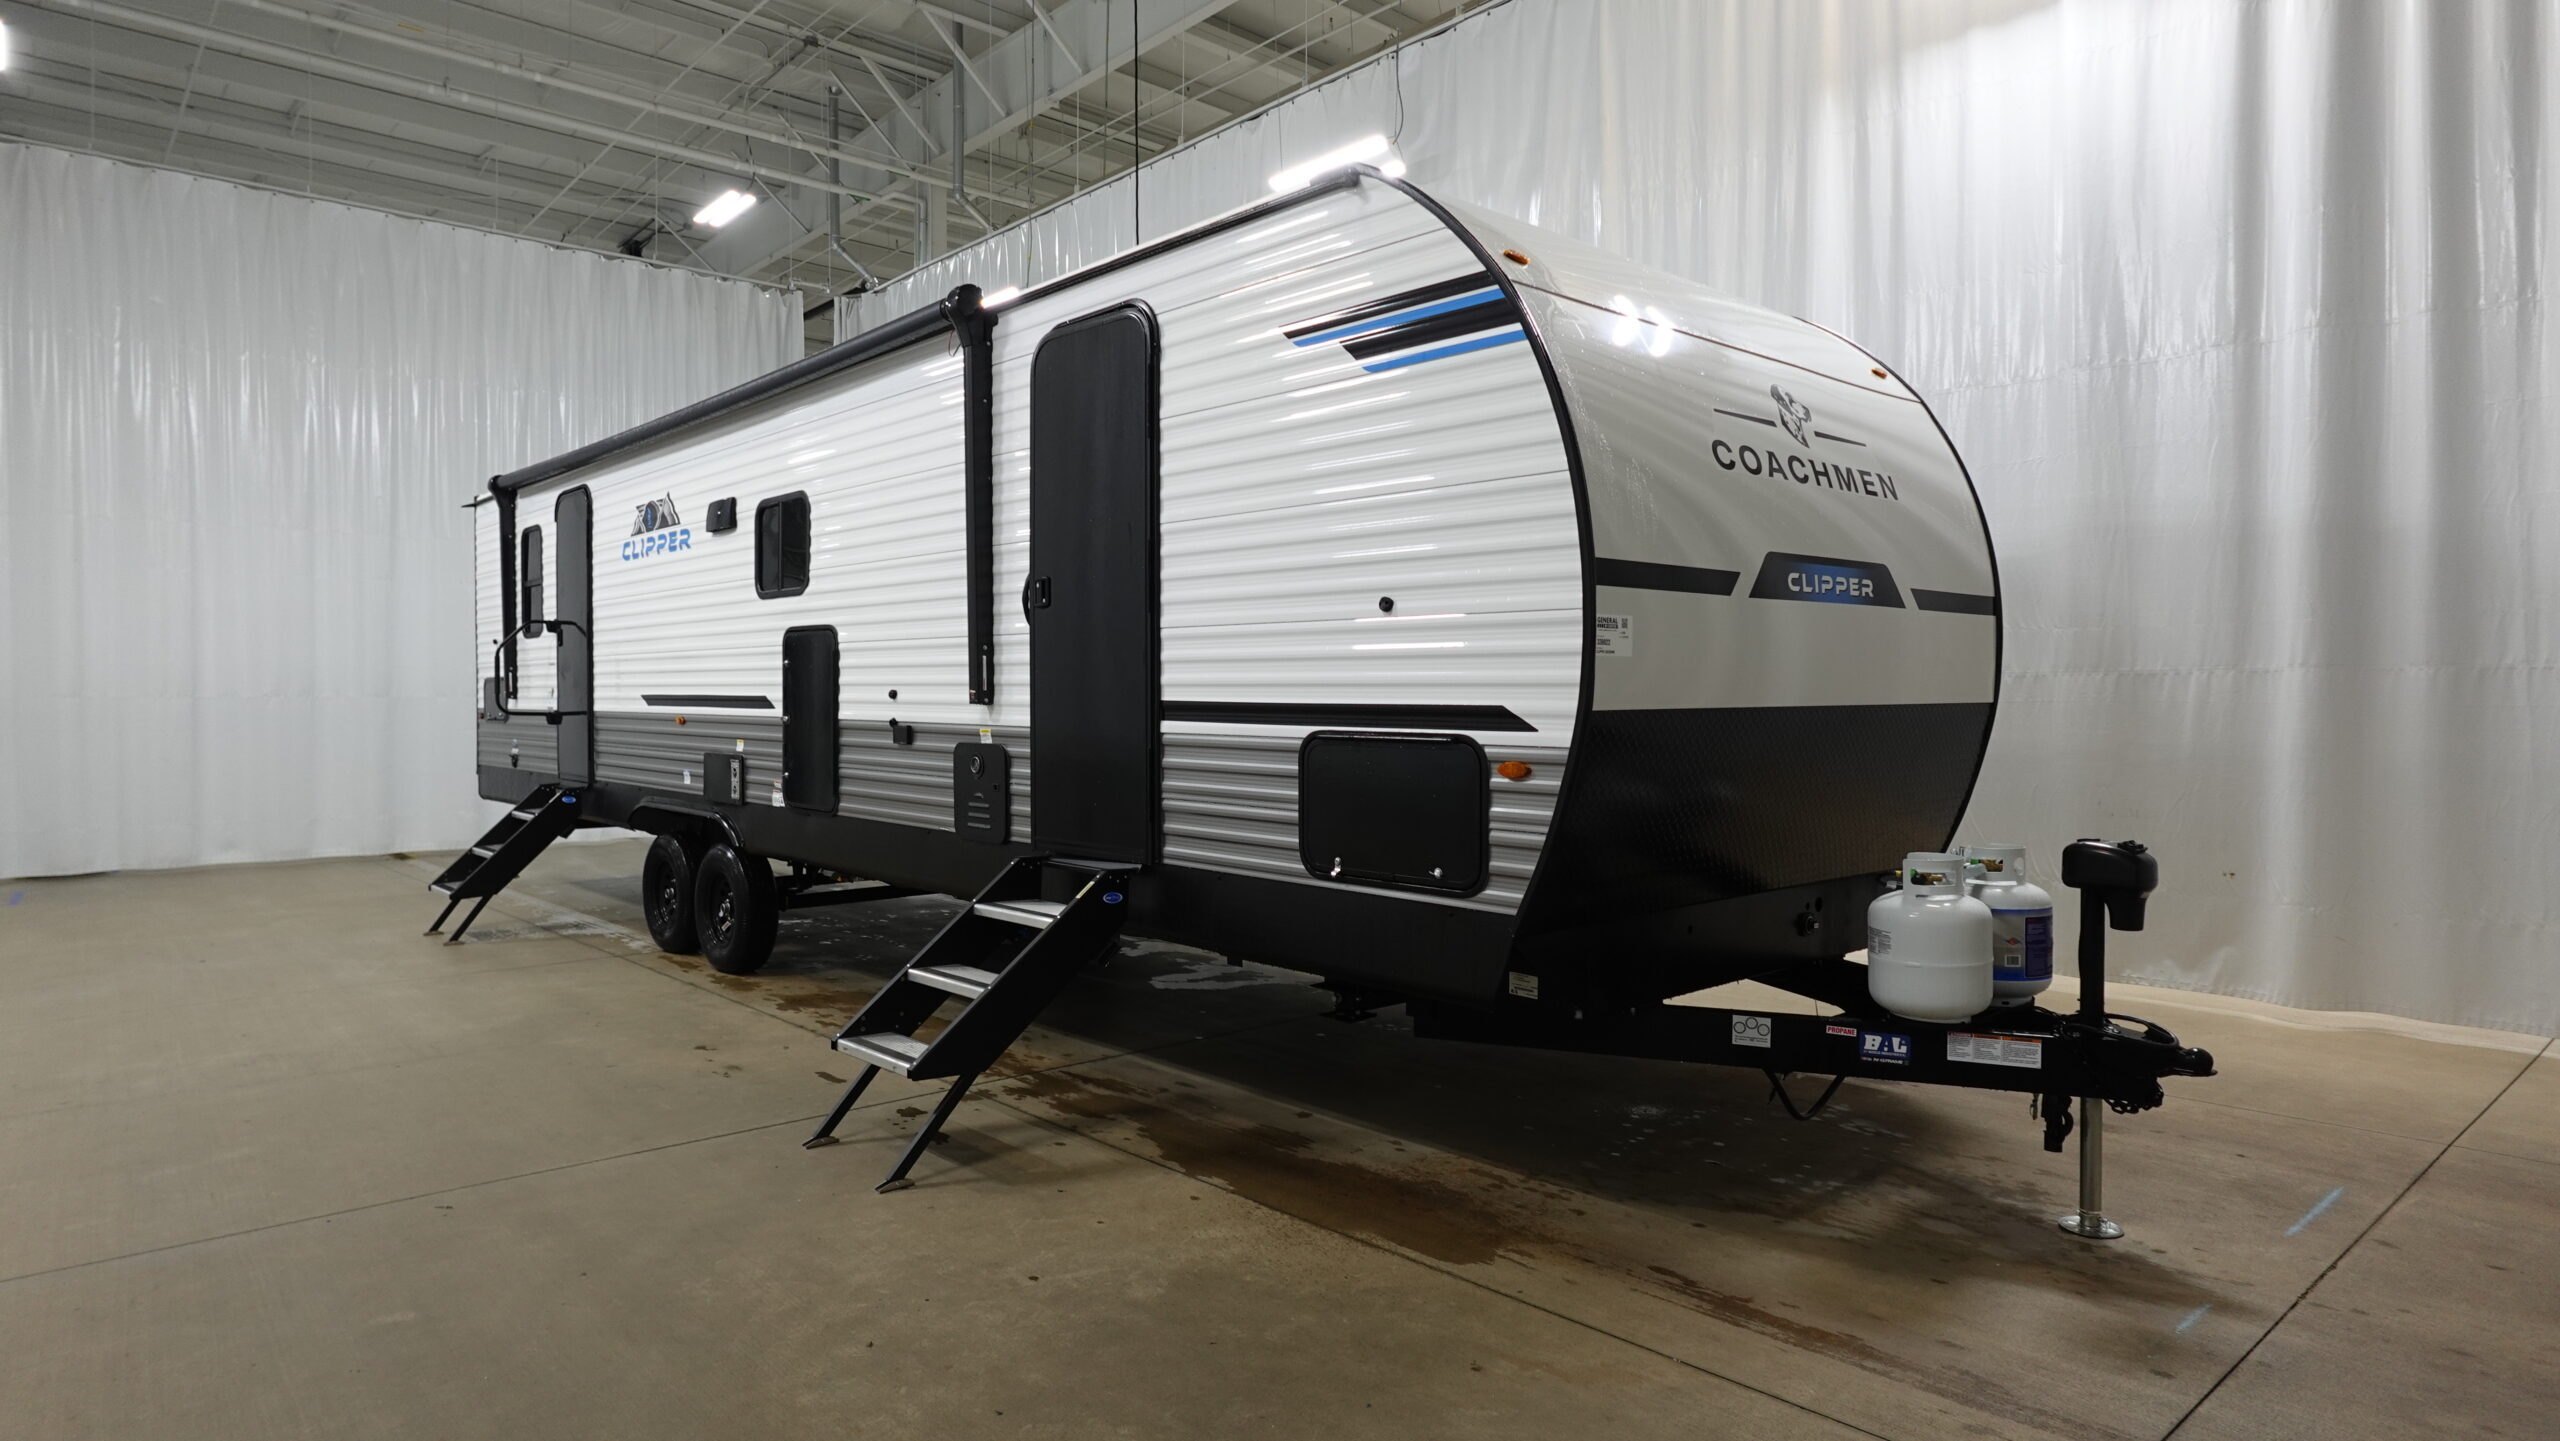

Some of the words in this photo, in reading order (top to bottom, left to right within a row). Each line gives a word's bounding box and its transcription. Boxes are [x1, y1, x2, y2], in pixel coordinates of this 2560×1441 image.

[1711, 439, 1899, 501] COACHMEN
[622, 528, 691, 561] CLIPPER
[1787, 572, 1874, 598] CLIPPER
[1827, 1026, 1856, 1035] PROPANE
[1863, 1034, 1908, 1054] BAL
